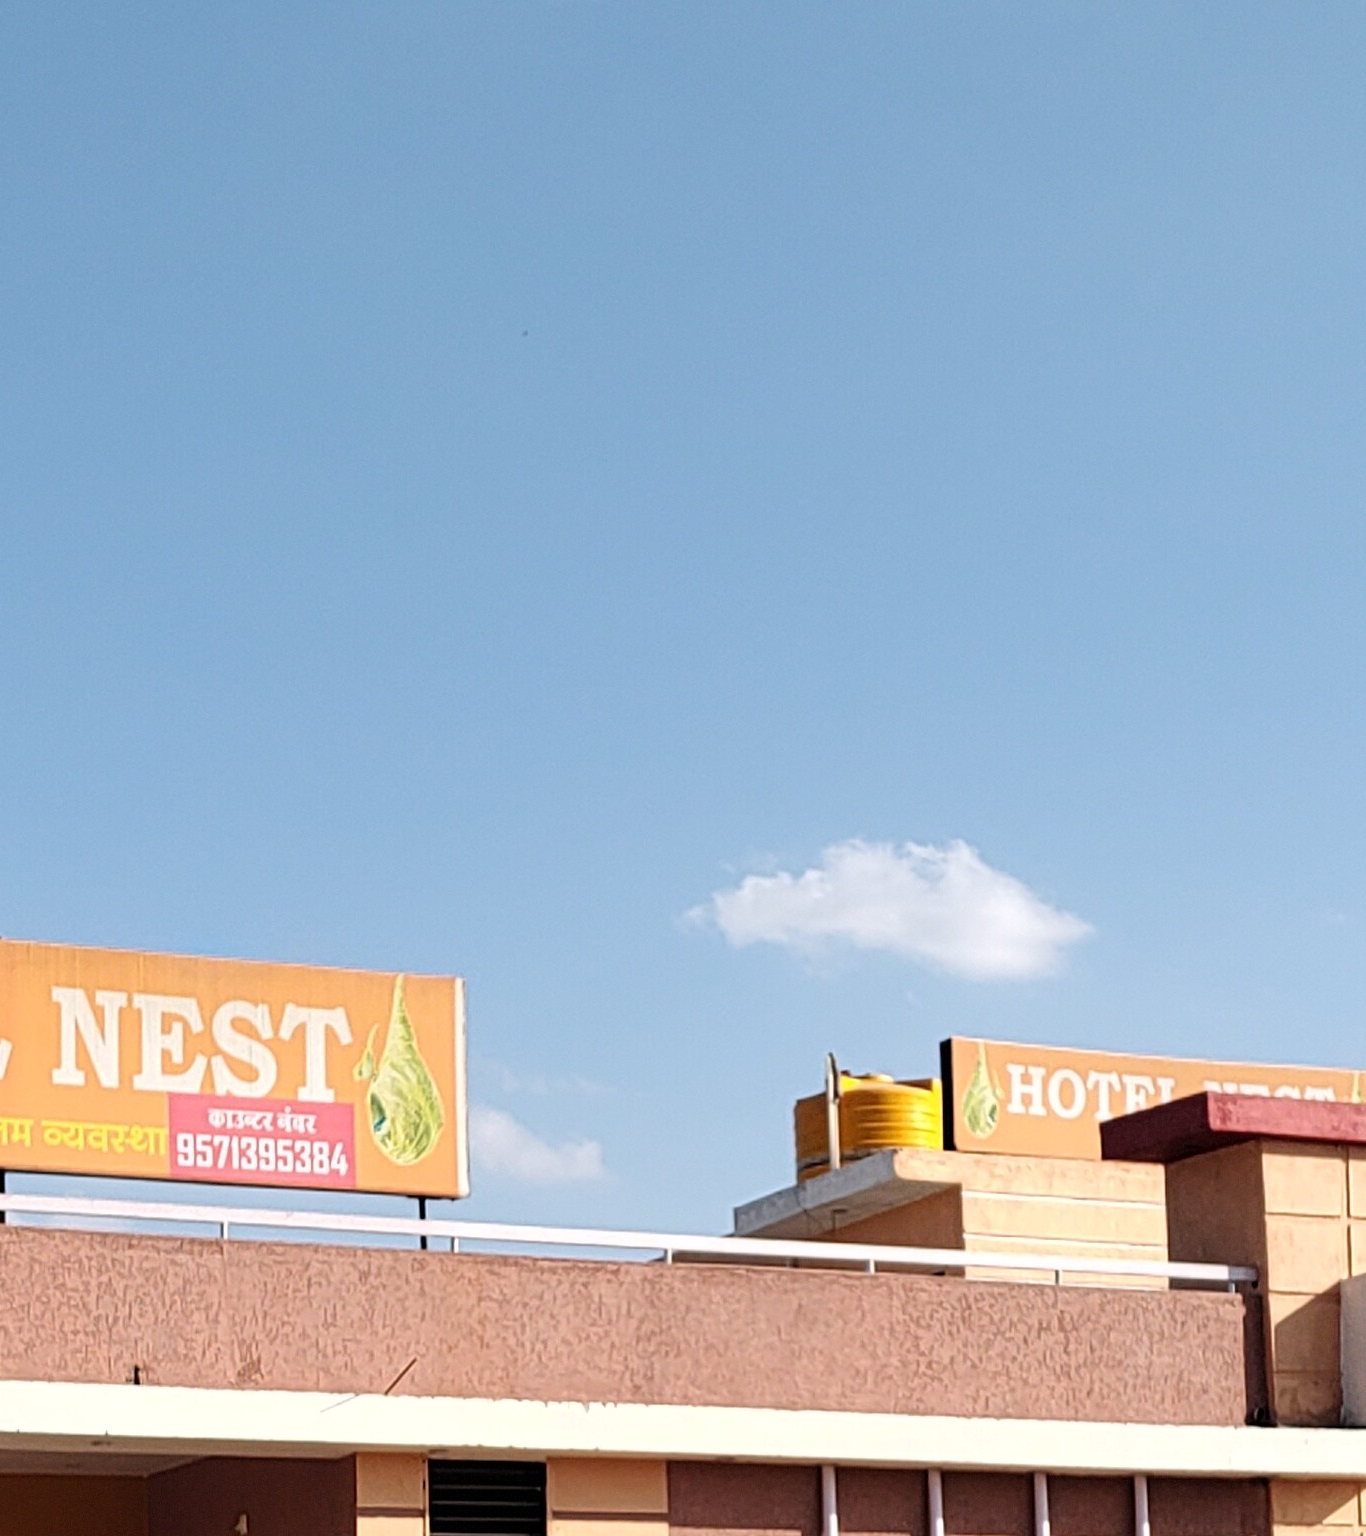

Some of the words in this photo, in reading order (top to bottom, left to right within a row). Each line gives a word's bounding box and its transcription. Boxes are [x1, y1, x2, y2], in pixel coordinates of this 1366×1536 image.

[51, 985, 353, 1104] NEST
[41, 1119, 169, 1157] व्यवस्था
[176, 1132, 349, 1176] 9571395384
